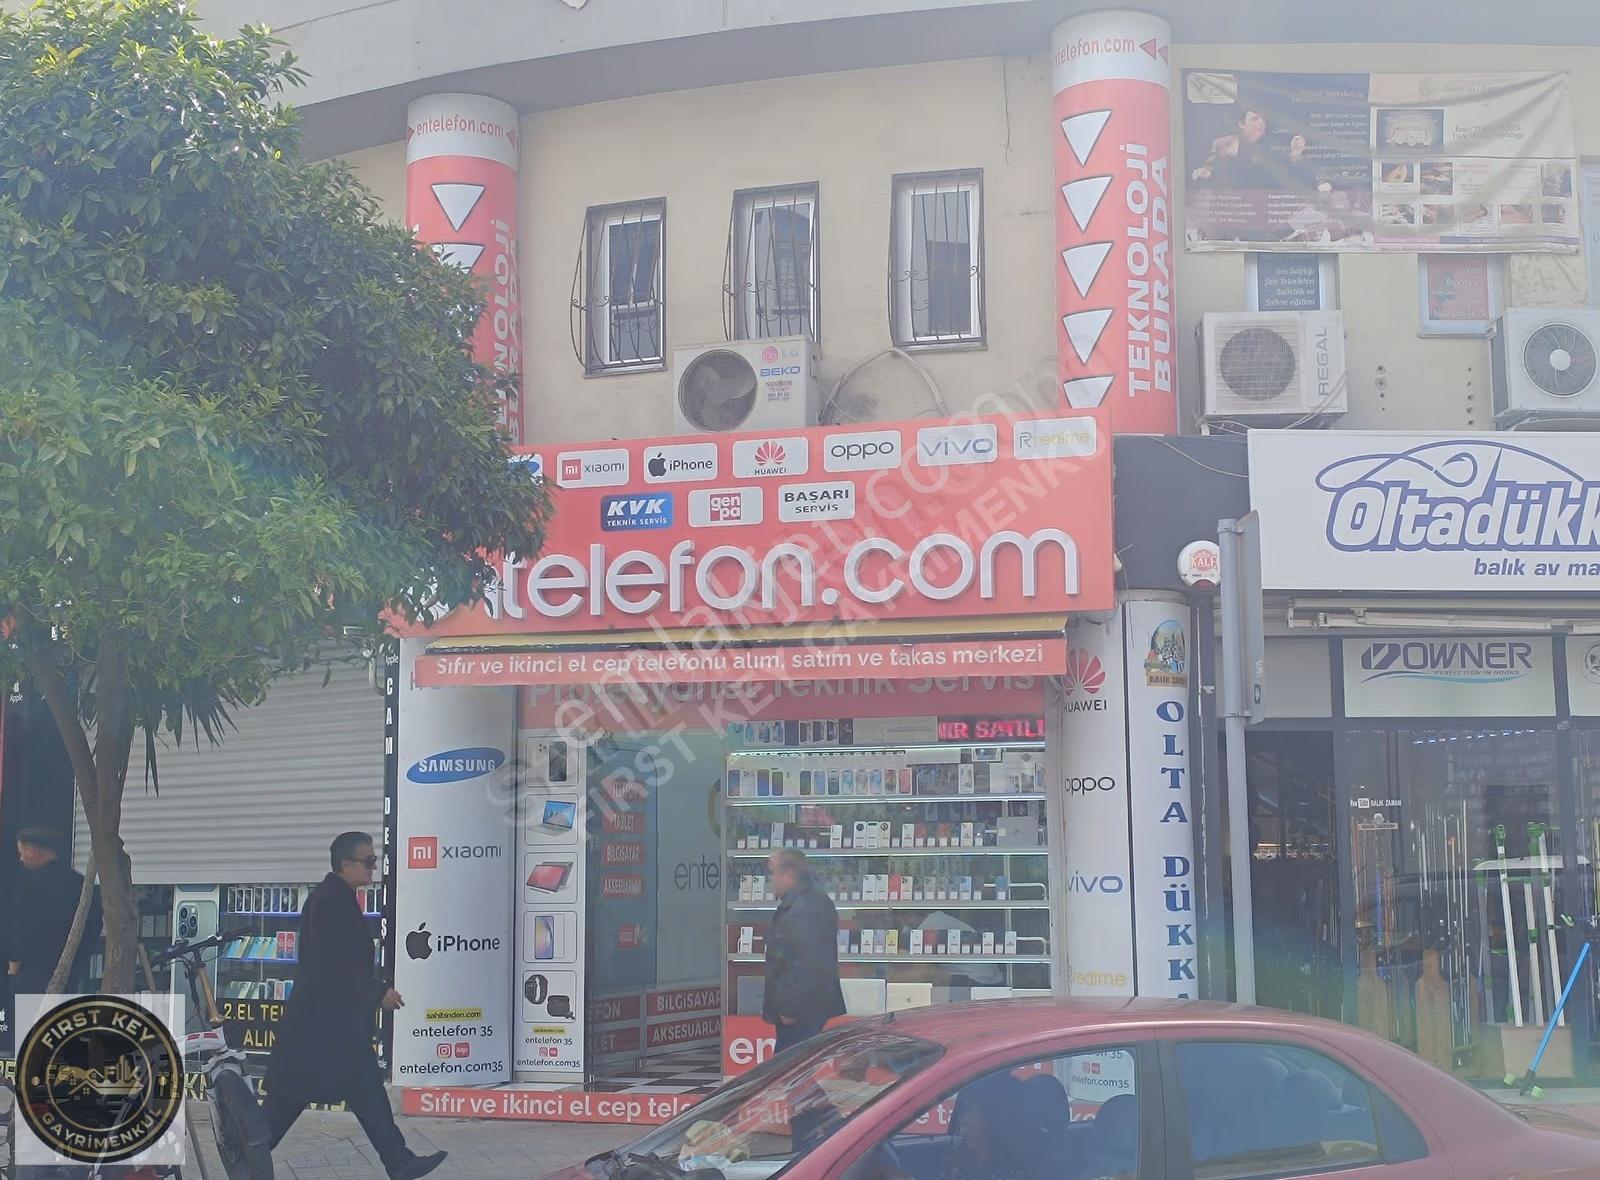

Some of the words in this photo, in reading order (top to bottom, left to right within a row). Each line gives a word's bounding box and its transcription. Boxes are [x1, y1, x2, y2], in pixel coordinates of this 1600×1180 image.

[416, 114, 504, 136] entelefon.com
[1151, 156, 1172, 393] BURADA
[1315, 326, 1330, 396] REGAL
[760, 366, 801, 377] BEKO
[920, 437, 994, 457] vivo
[1034, 431, 1090, 446] realme
[830, 442, 894, 461] oppo
[668, 459, 713, 472] iPhone
[754, 467, 787, 476] HUAWEI
[710, 495, 742, 509] gen
[784, 489, 850, 504] BAŞARI
[607, 498, 667, 517] KVK
[719, 505, 742, 521] pa
[795, 502, 839, 514] SERVİS
[607, 518, 637, 527] TEKNİK
[639, 516, 668, 526] SERVİS
[1474, 557, 1526, 576] balık
[1534, 561, 1560, 576] av
[436, 656, 475, 676] Sıfır
[480, 661, 504, 675] ve
[508, 656, 562, 674] ikinci
[568, 654, 587, 673] el
[592, 656, 632, 676] cep
[636, 652, 727, 672] telefonu
[791, 649, 852, 669] satım
[858, 653, 883, 667] ve
[890, 647, 946, 667] takas
[952, 643, 1044, 665] merkezi
[1402, 642, 1533, 670] OWNER
[418, 758, 497, 773] SAMSUNG
[1156, 700, 1188, 823] OLTA
[1064, 776, 1116, 796] oppo
[437, 934, 501, 952] iPhone
[223, 1002, 255, 1020] 2.EL
[412, 1025, 477, 1038] entelefon
[480, 1025, 493, 1038] 35
[525, 1036, 562, 1045] entelefon
[563, 1038, 573, 1046] 35
[399, 1060, 504, 1075] entelefon.com35
[420, 1093, 466, 1114] Sıfır
[470, 1098, 497, 1114] ve
[502, 1093, 563, 1116] ikinci
[569, 1095, 592, 1117] el
[597, 1099, 642, 1123] cep
